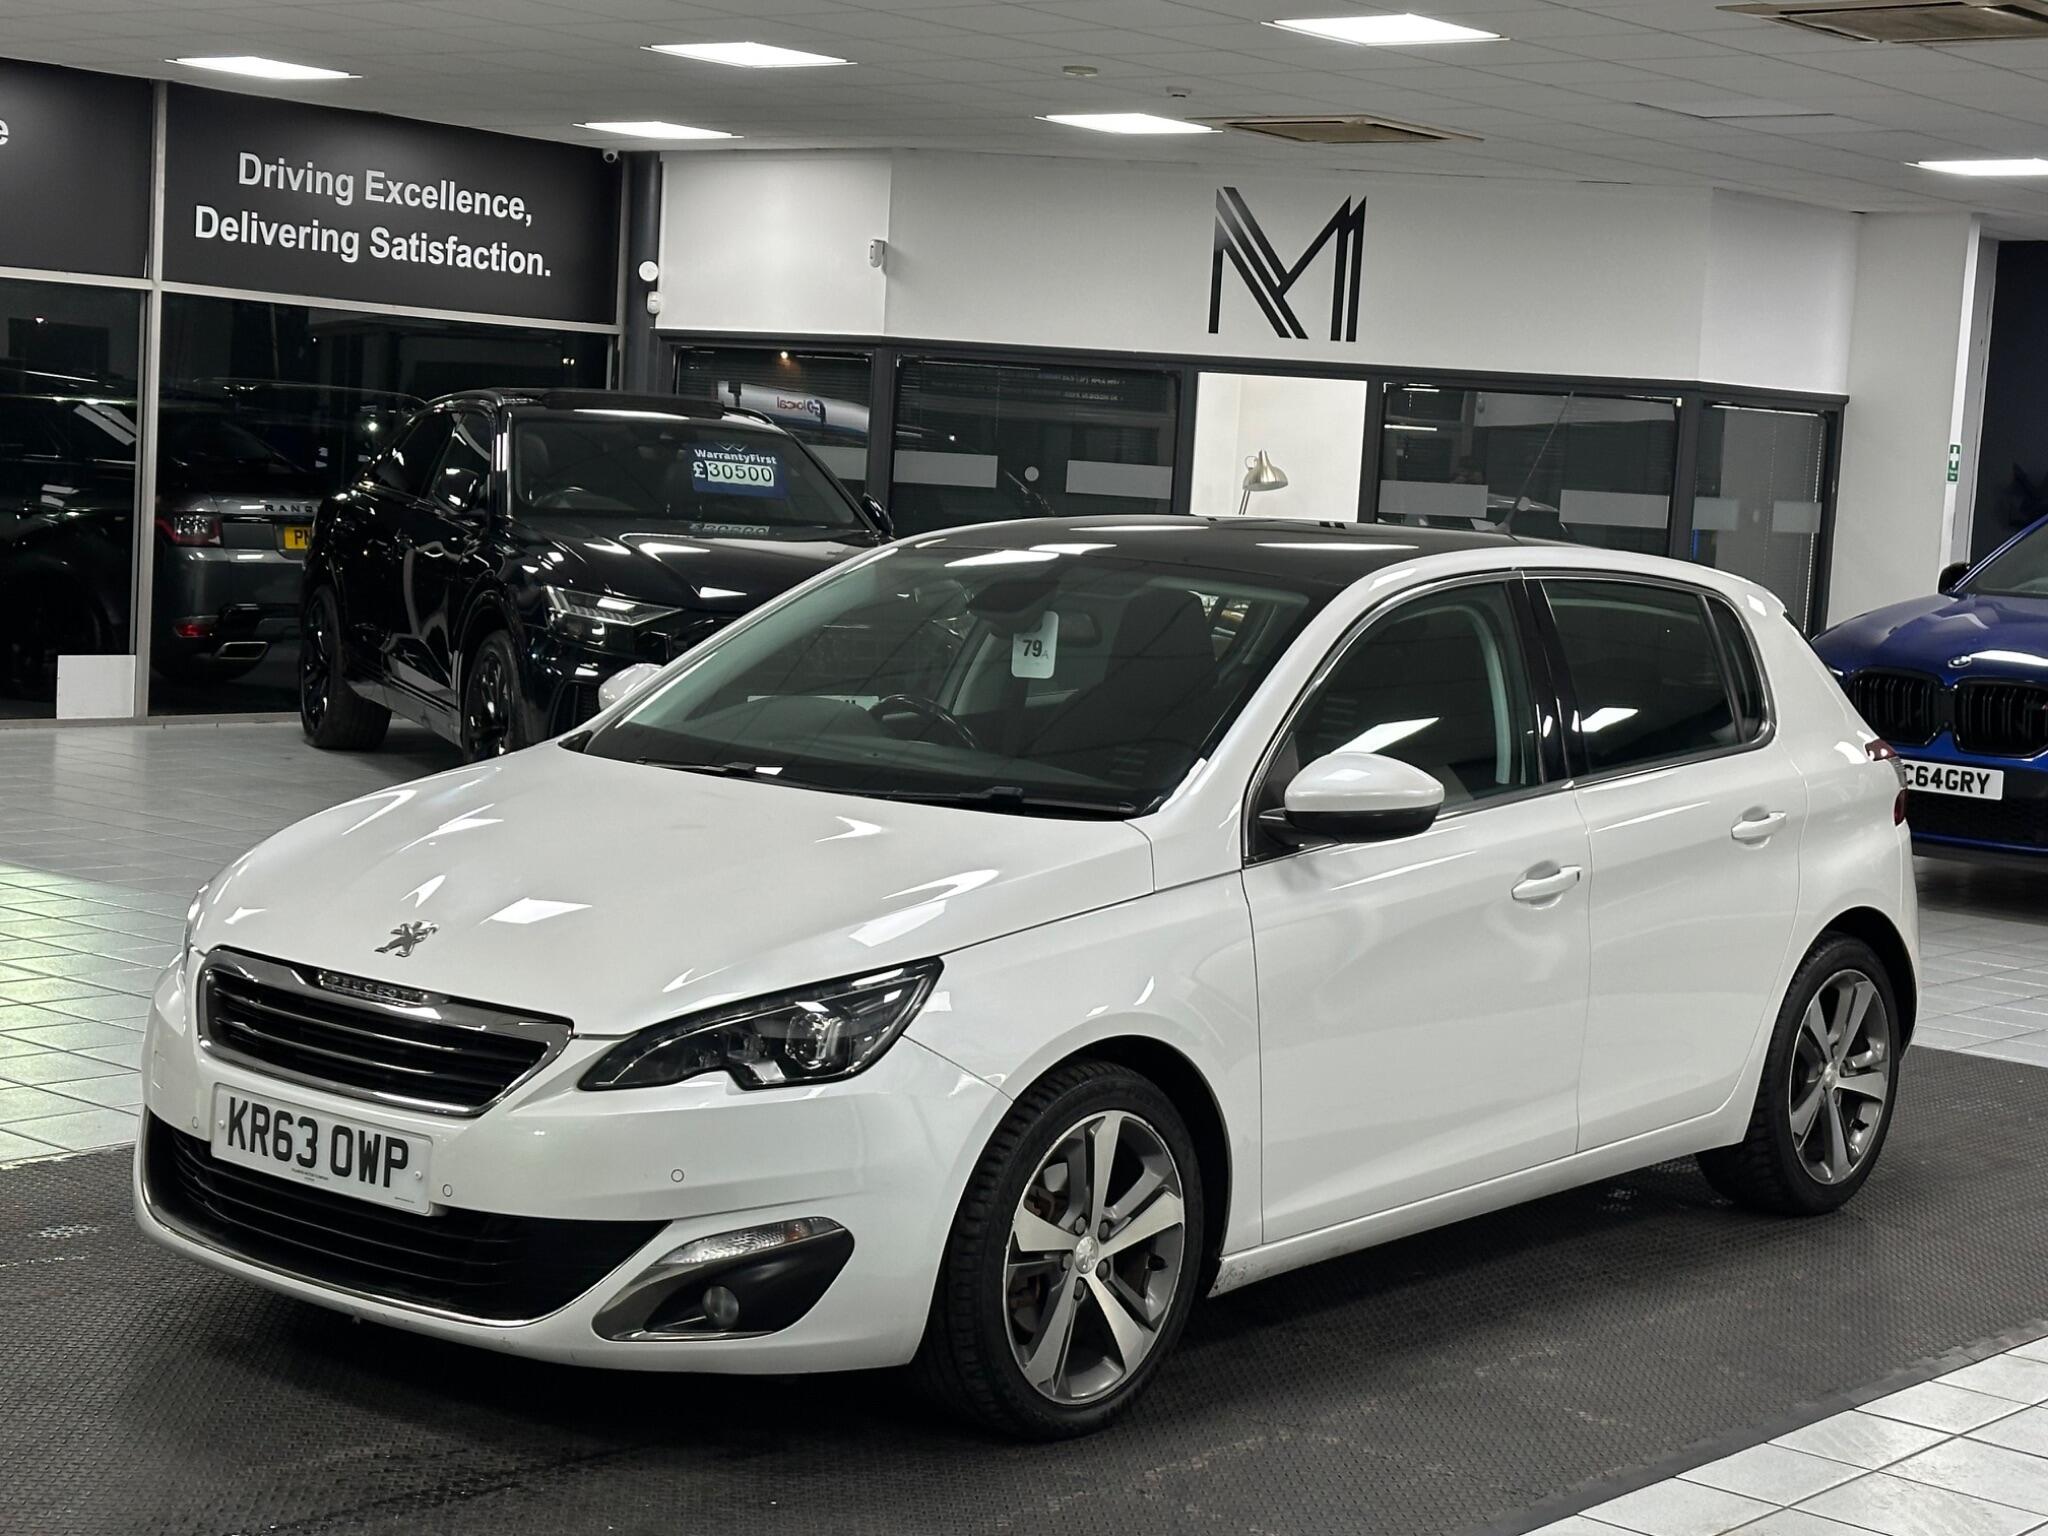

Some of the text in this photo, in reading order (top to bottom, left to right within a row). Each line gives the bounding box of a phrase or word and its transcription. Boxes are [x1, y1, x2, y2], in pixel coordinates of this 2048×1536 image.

[239, 152, 532, 227] Driving Excellence,
[195, 205, 551, 277] Delivering Satisfaction.
[694, 449, 777, 464] WarrantyFirst
[227, 1097, 409, 1188] KR63 OWP
